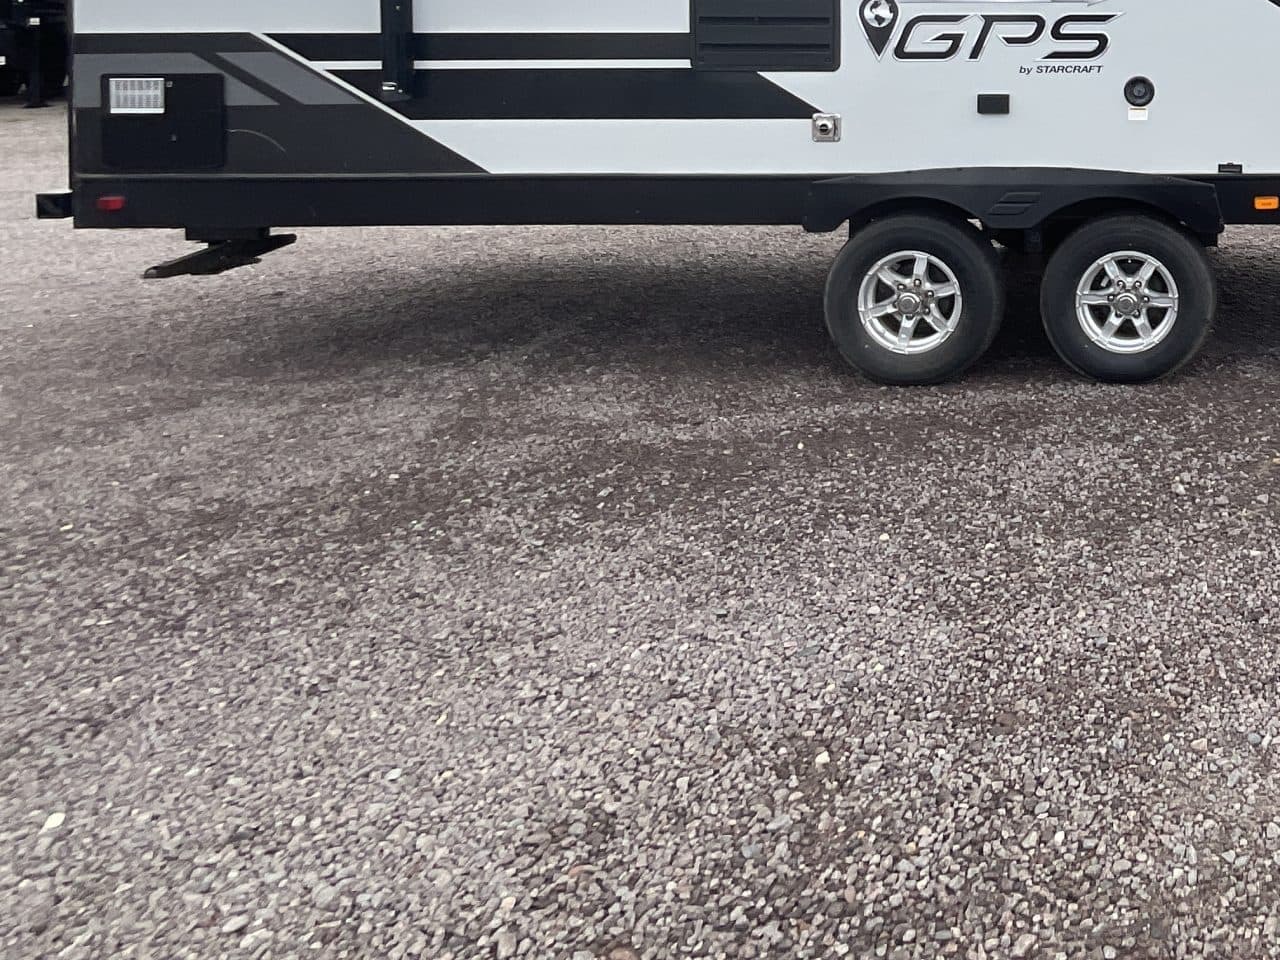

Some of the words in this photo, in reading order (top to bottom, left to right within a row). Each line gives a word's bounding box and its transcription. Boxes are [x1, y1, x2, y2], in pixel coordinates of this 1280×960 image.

[892, 13, 1121, 61] GPS
[1019, 65, 1033, 75] by
[1036, 65, 1103, 74] STARCRAFT
